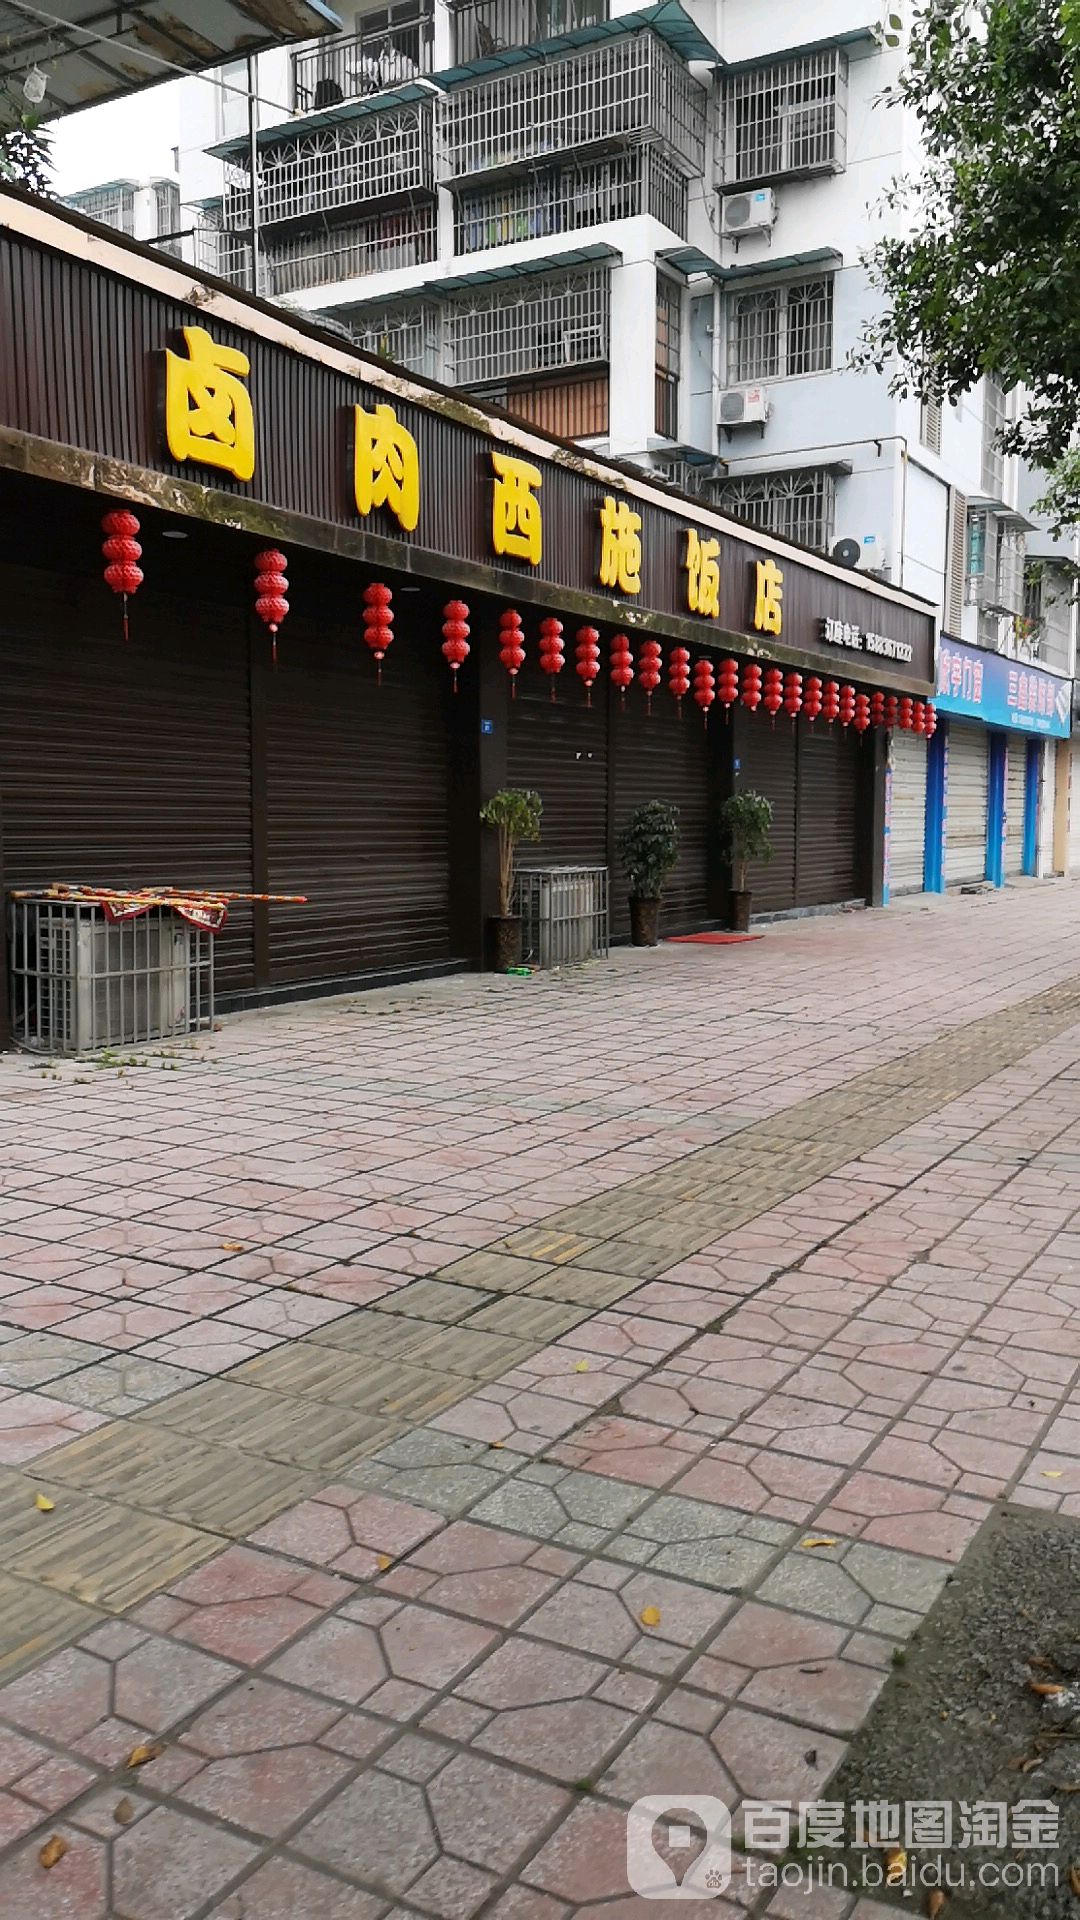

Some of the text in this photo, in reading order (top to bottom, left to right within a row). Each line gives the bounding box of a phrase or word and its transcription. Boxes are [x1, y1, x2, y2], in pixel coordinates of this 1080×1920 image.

[165, 325, 784, 636] 卤肉西施饭店
